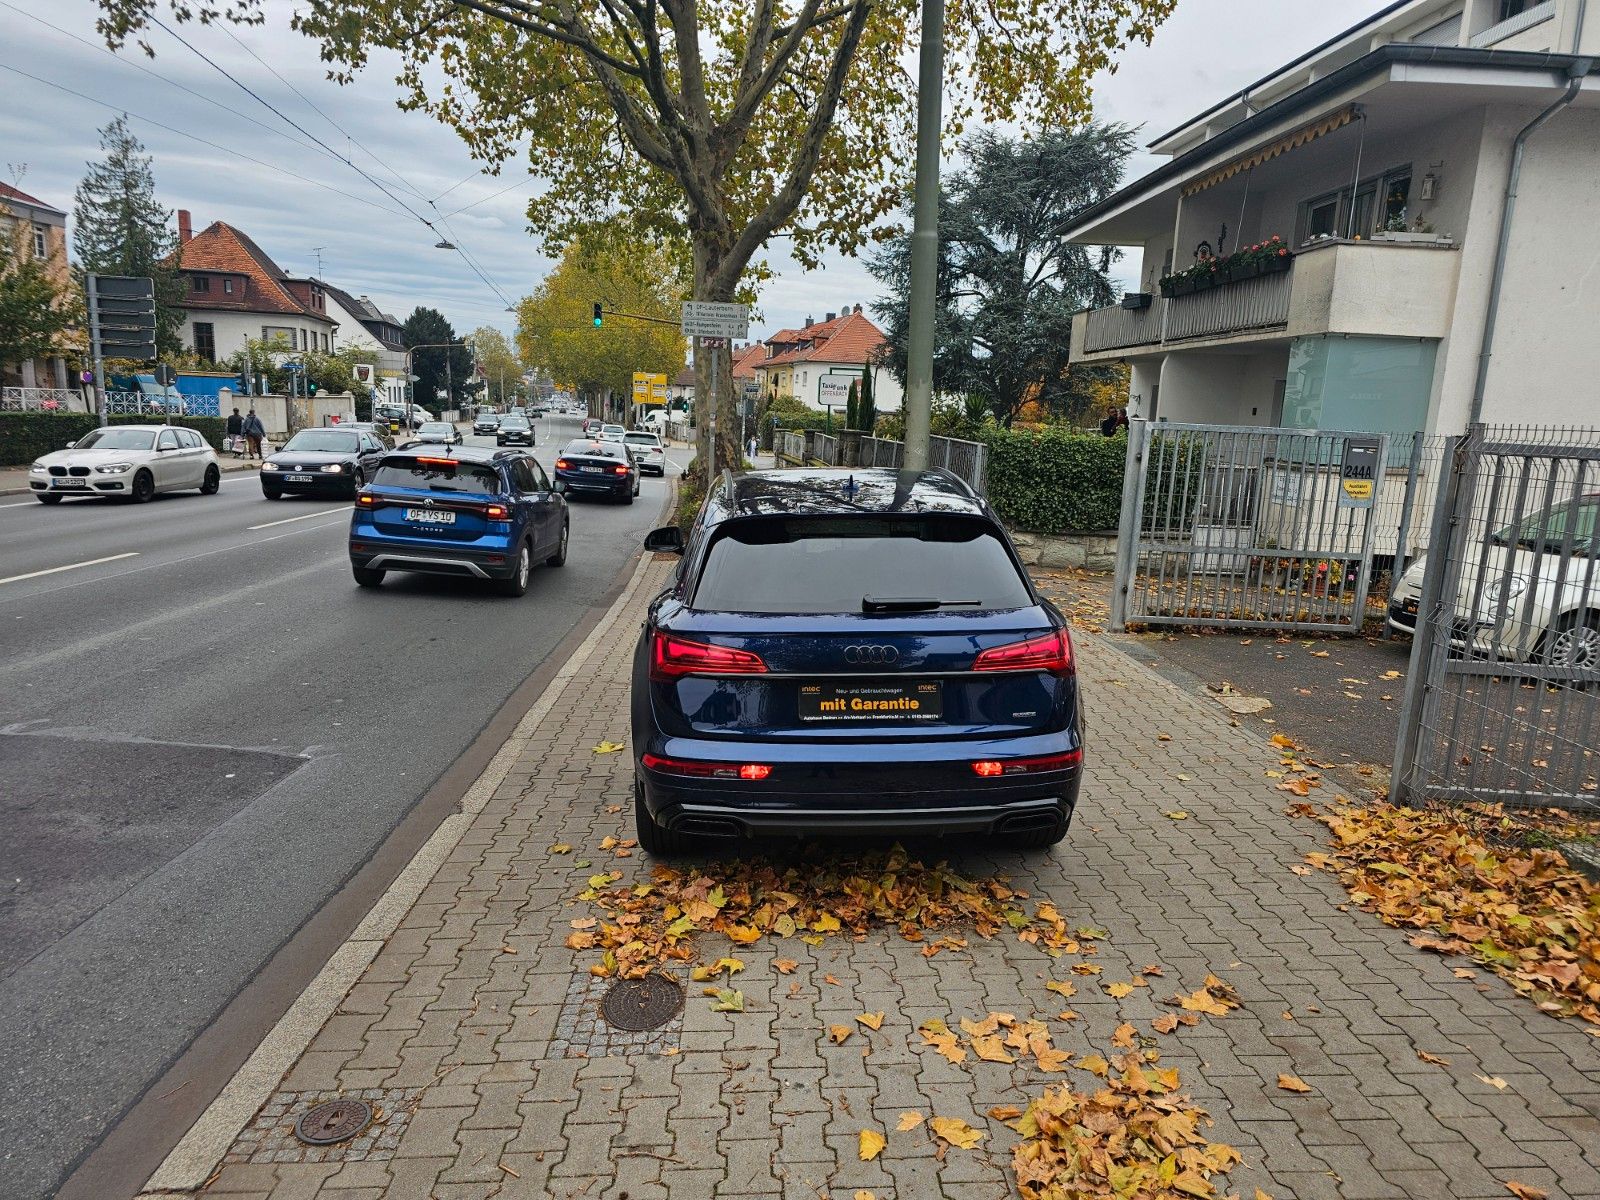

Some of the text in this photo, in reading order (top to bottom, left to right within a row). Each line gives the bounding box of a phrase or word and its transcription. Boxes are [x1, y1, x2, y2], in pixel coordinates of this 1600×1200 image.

[1345, 464, 1372, 478] 244A
[410, 509, 452, 521] OF YS 10
[820, 697, 919, 710] mit Garantie
